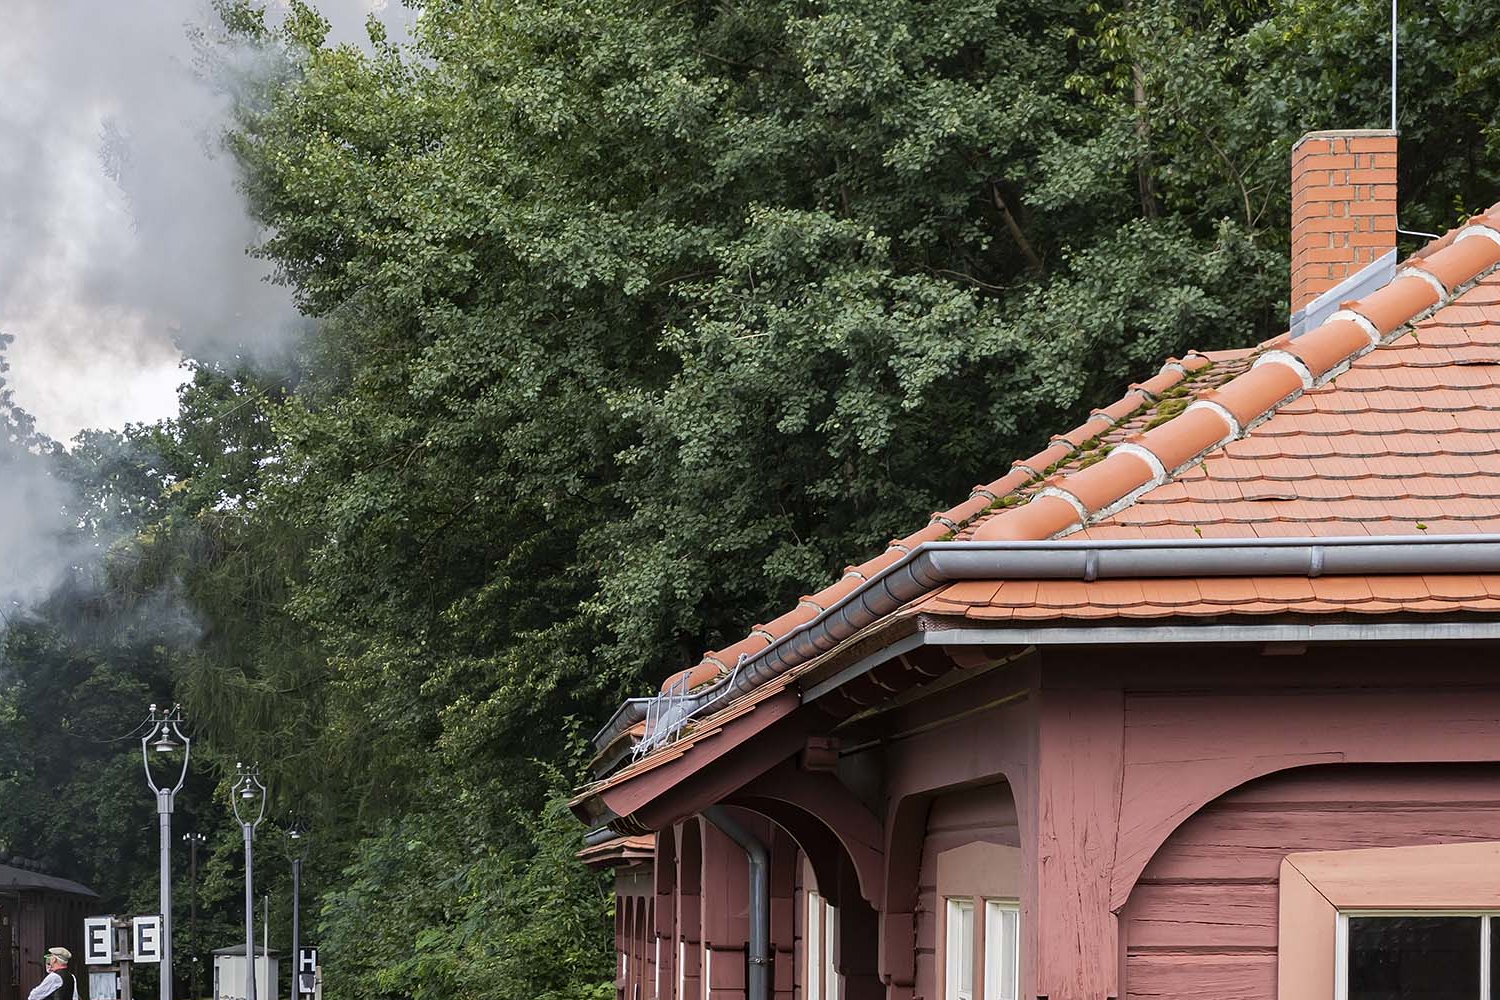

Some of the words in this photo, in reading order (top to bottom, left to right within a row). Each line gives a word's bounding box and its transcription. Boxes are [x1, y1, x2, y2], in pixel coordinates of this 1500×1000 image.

[88, 924, 107, 958] E
[137, 923, 156, 956] E
[299, 949, 317, 972] H
